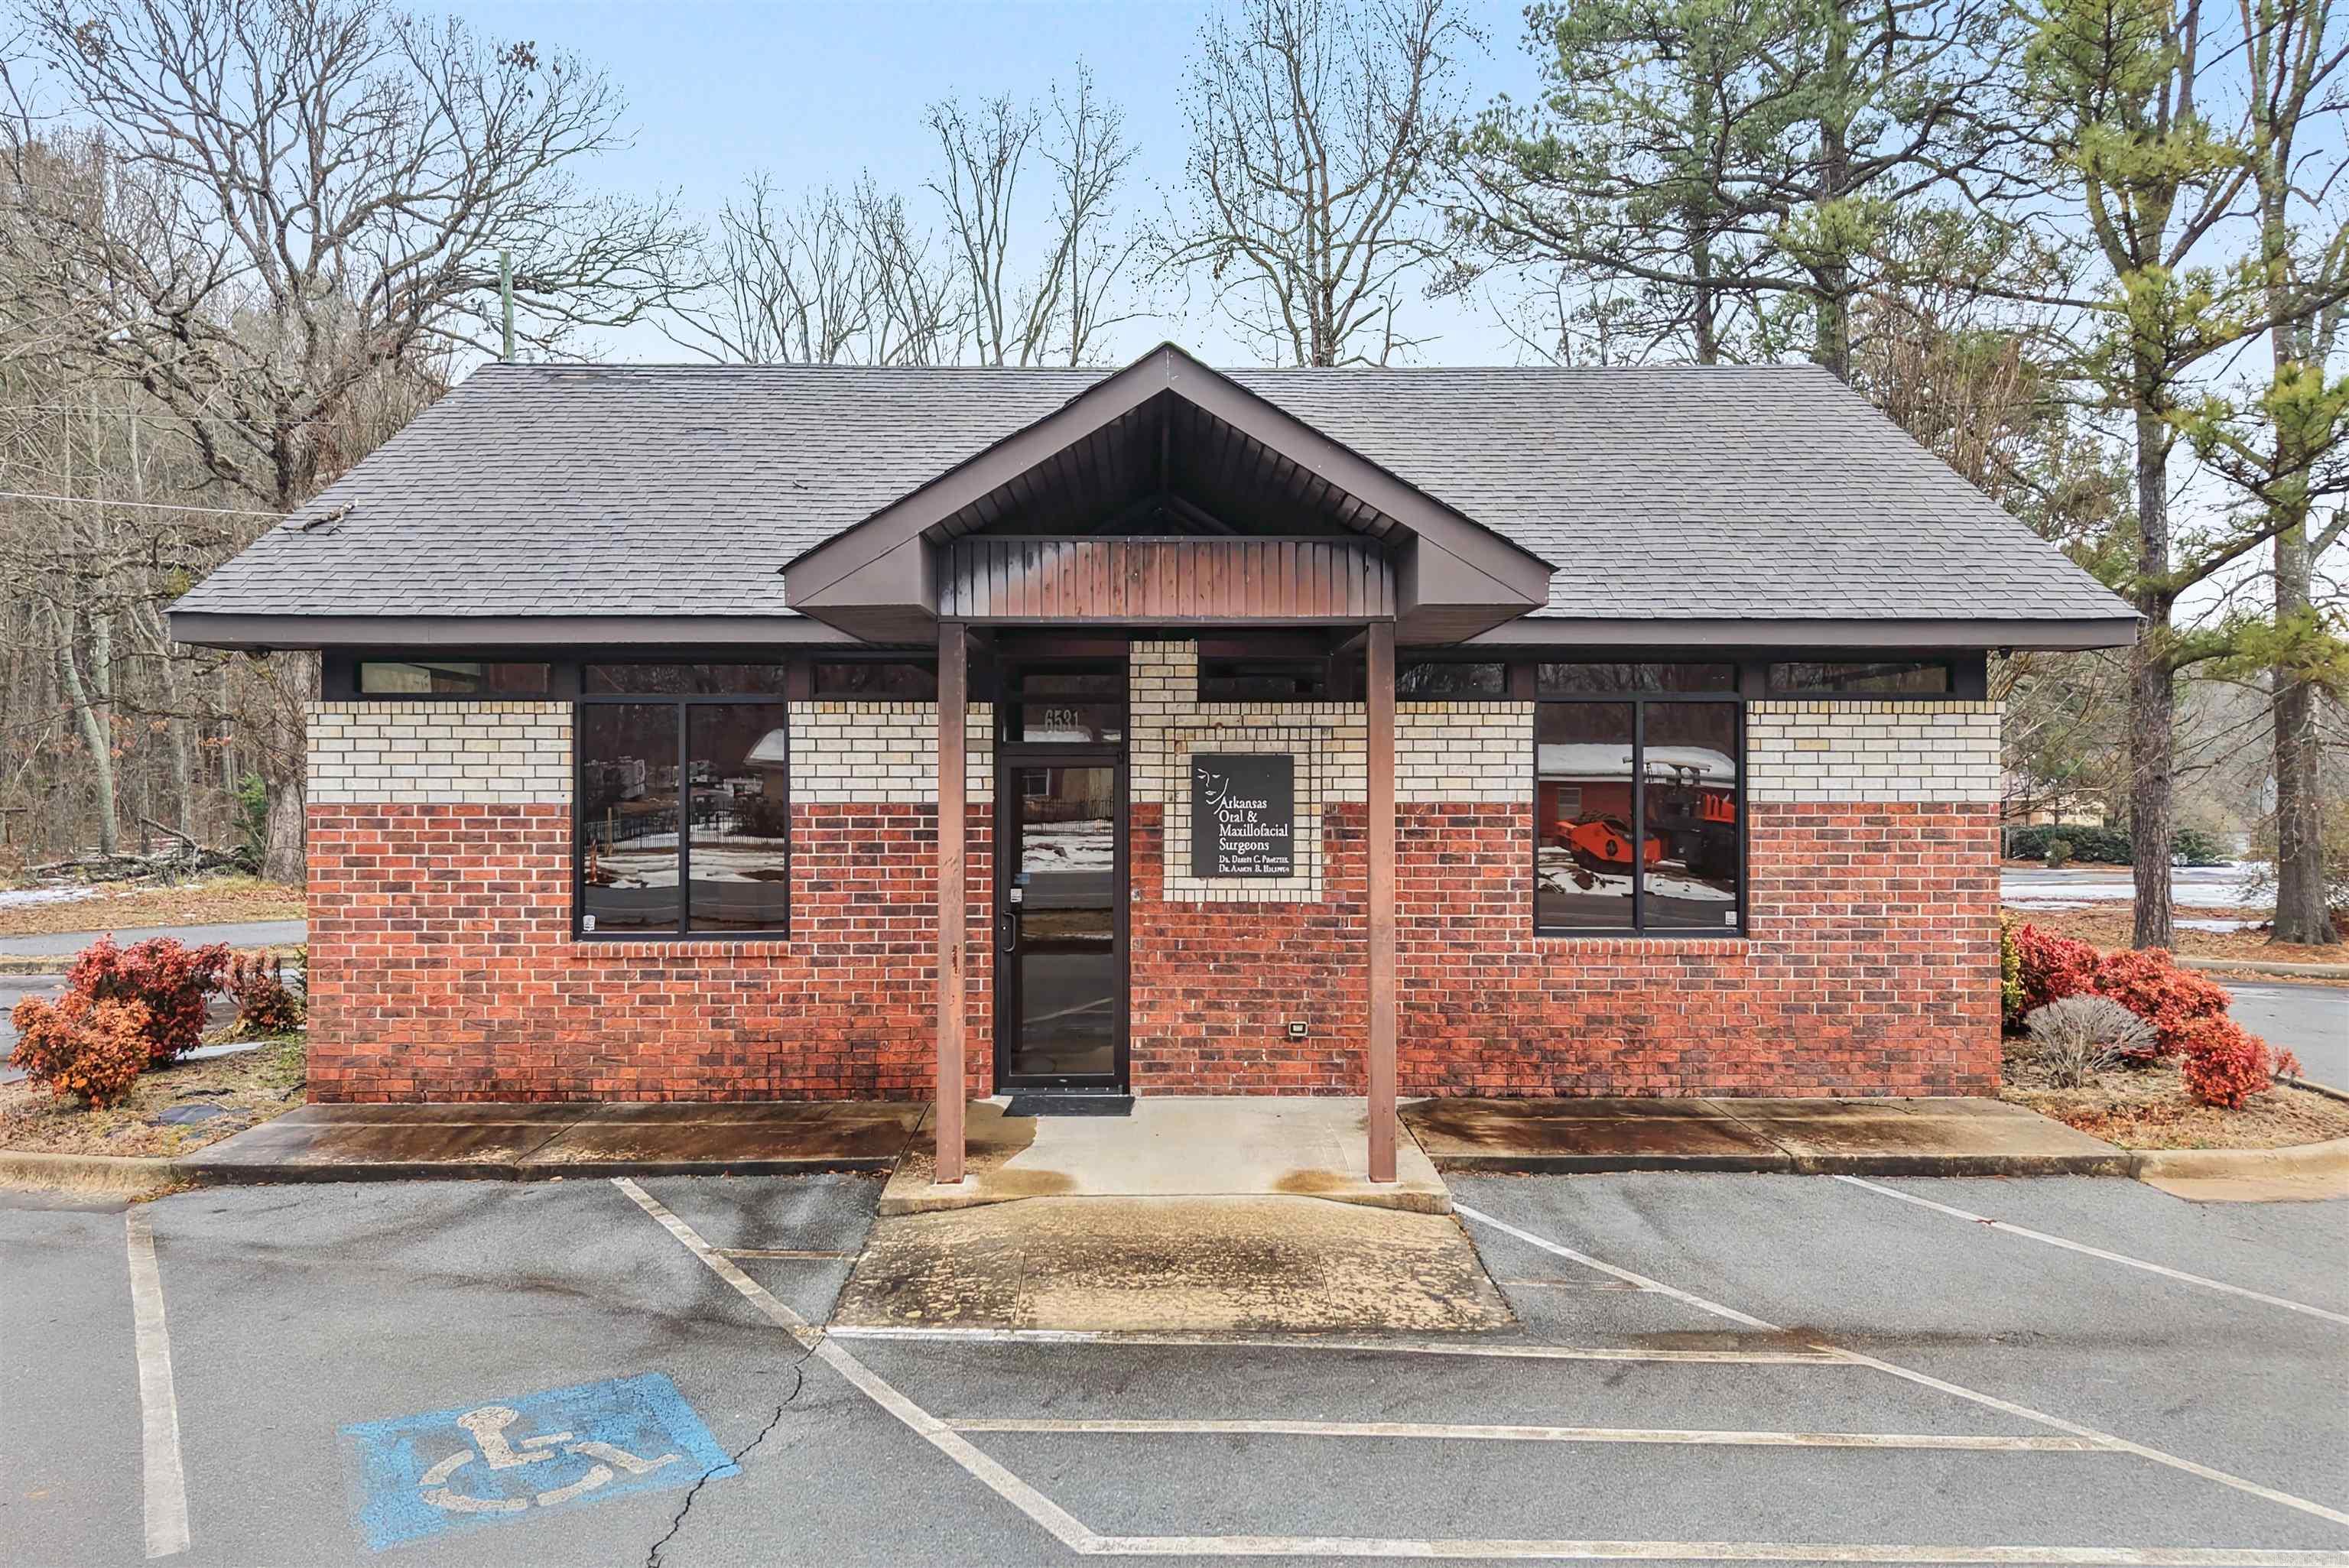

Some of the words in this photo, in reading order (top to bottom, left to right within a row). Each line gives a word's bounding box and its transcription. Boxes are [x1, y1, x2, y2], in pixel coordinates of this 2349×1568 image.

[1045, 709, 1079, 732] 6531
[1219, 795, 1267, 809] Arkansas
[1219, 810, 1244, 823] Oral
[1247, 810, 1258, 823] &
[1219, 823, 1288, 837] Maxillofacial
[1219, 838, 1269, 855] Surgeons
